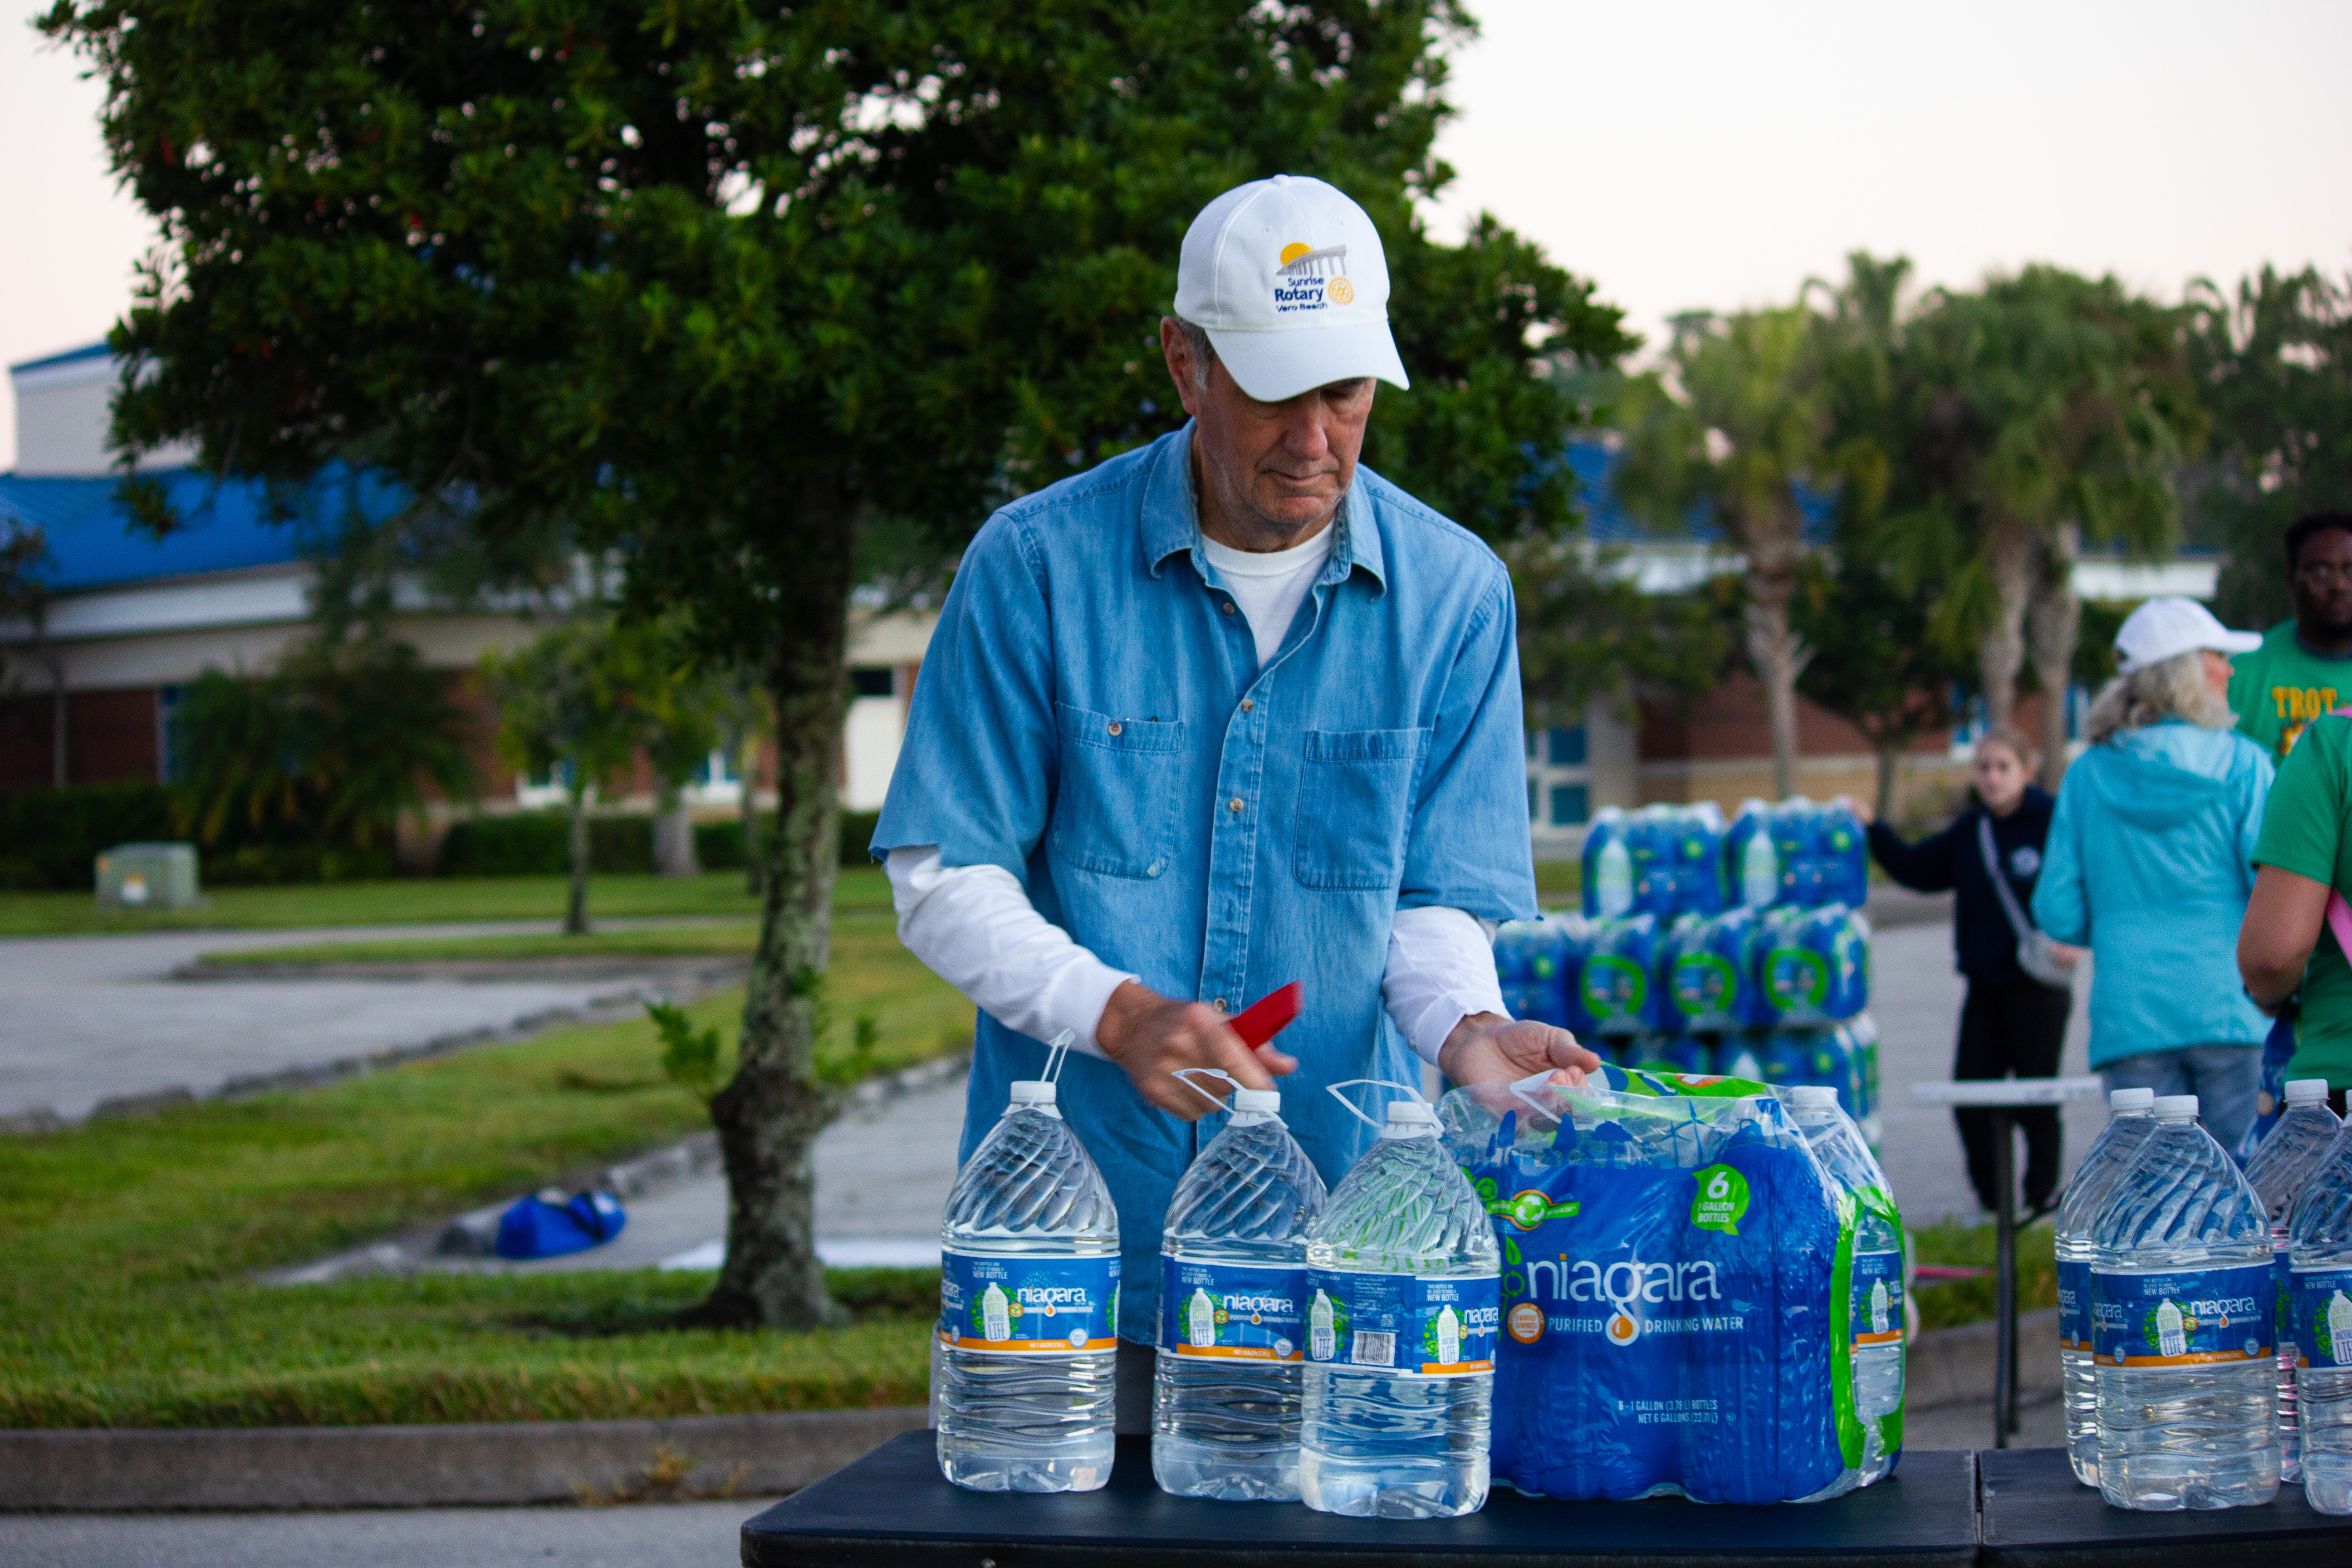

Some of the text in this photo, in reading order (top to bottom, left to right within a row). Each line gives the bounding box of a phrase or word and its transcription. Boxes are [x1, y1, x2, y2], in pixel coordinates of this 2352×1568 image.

[1288, 277, 1324, 287] Sunrise
[1274, 287, 1323, 302] Rotary
[1299, 302, 1328, 310] Beach
[2271, 686, 2337, 719] TROT
[1707, 1171, 1730, 1199] 6
[1702, 1202, 1735, 1212] GALLON
[1697, 1213, 1730, 1223] BOTTLES
[1193, 1277, 1214, 1285] BOTTLE
[2317, 1280, 2337, 1289] BOTTLE
[1527, 1253, 1722, 1346] niagara
[2159, 1287, 2180, 1295] BOTTLE
[1017, 1285, 1087, 1317] niagara
[1224, 1293, 1294, 1325] niagara
[2190, 1297, 2256, 1328] niagara
[1441, 1325, 1456, 1337] BOTTLE
[1465, 1307, 1499, 1338] niagara
[1548, 1316, 1743, 1333] PURIFIED DRINKING WATER
[2161, 1317, 2180, 1330] BOTTLE
[988, 1323, 1005, 1340] LIFE
[1193, 1328, 1210, 1345] LIFE
[1442, 1345, 1456, 1363] LIFE
[2164, 1338, 2183, 1356] LIFE
[2337, 1341, 2352, 1362] LIF
[1636, 1400, 1663, 1411] GALLON
[1691, 1400, 1718, 1410] BOTTLES
[1638, 1413, 1652, 1423] NET
[1653, 1413, 1658, 1422] 6
[1660, 1413, 1690, 1423] GALLONS
